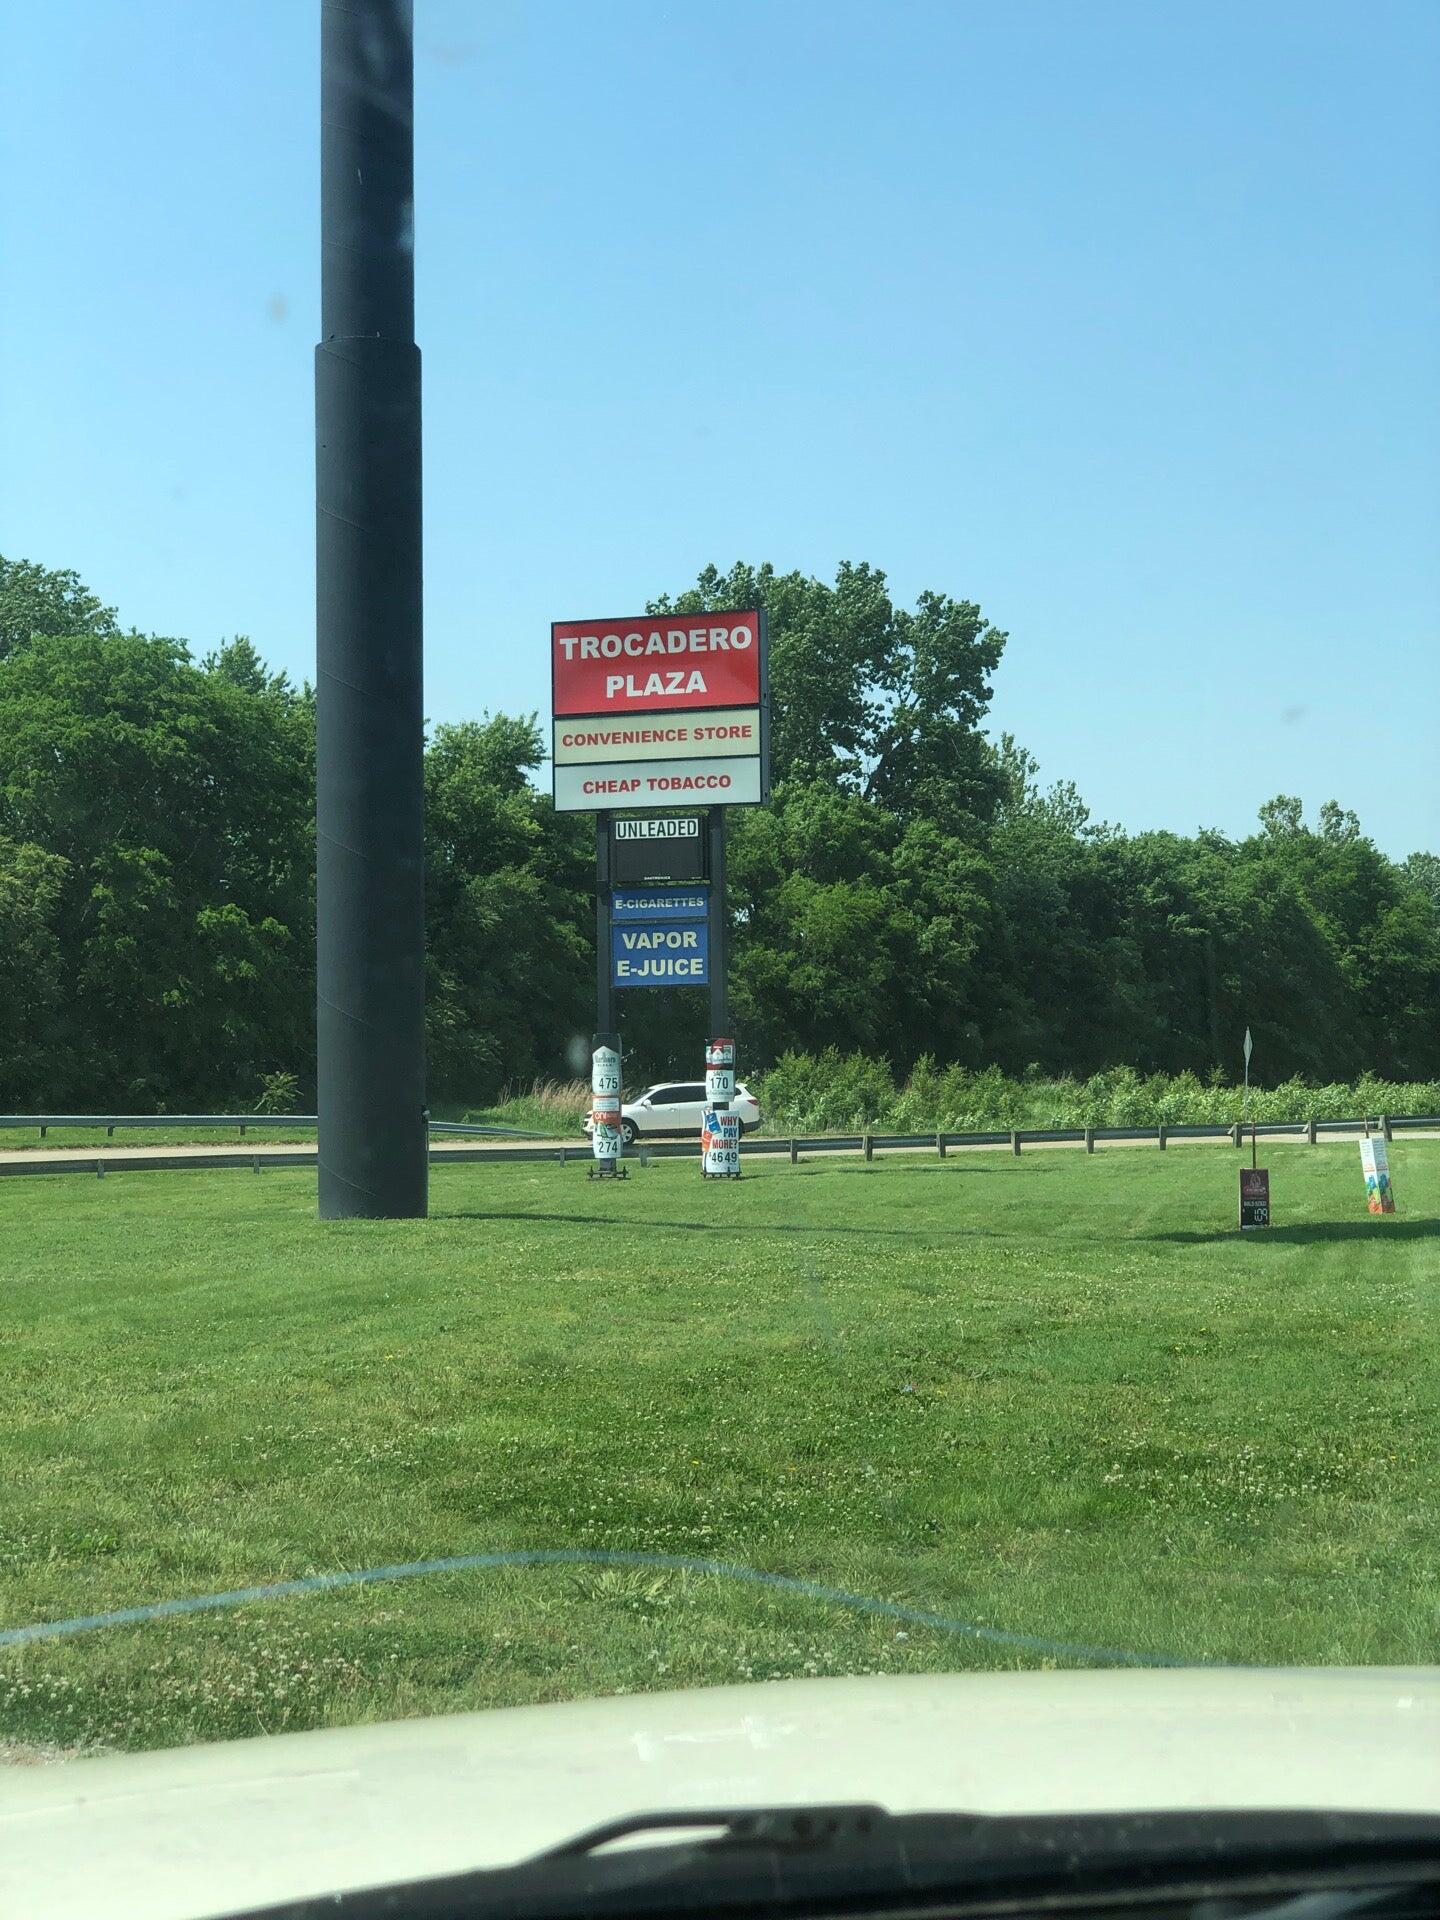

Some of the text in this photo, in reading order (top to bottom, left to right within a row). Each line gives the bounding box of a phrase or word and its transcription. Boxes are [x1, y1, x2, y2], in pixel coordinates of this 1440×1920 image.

[560, 626, 752, 660] TROCADERO
[606, 670, 707, 698] PLAZA
[562, 725, 752, 747] CONVENIENCE STORE
[582, 774, 732, 794] CHEAP TOBACCO
[617, 820, 697, 838] UNLEADED
[615, 897, 704, 909] E-CIGARETTES
[622, 931, 698, 950] VAPOR
[617, 958, 704, 977] E-JUICE
[719, 1115, 738, 1126] WHY
[723, 1127, 738, 1138] PAY
[712, 1139, 738, 1150] MORE?
